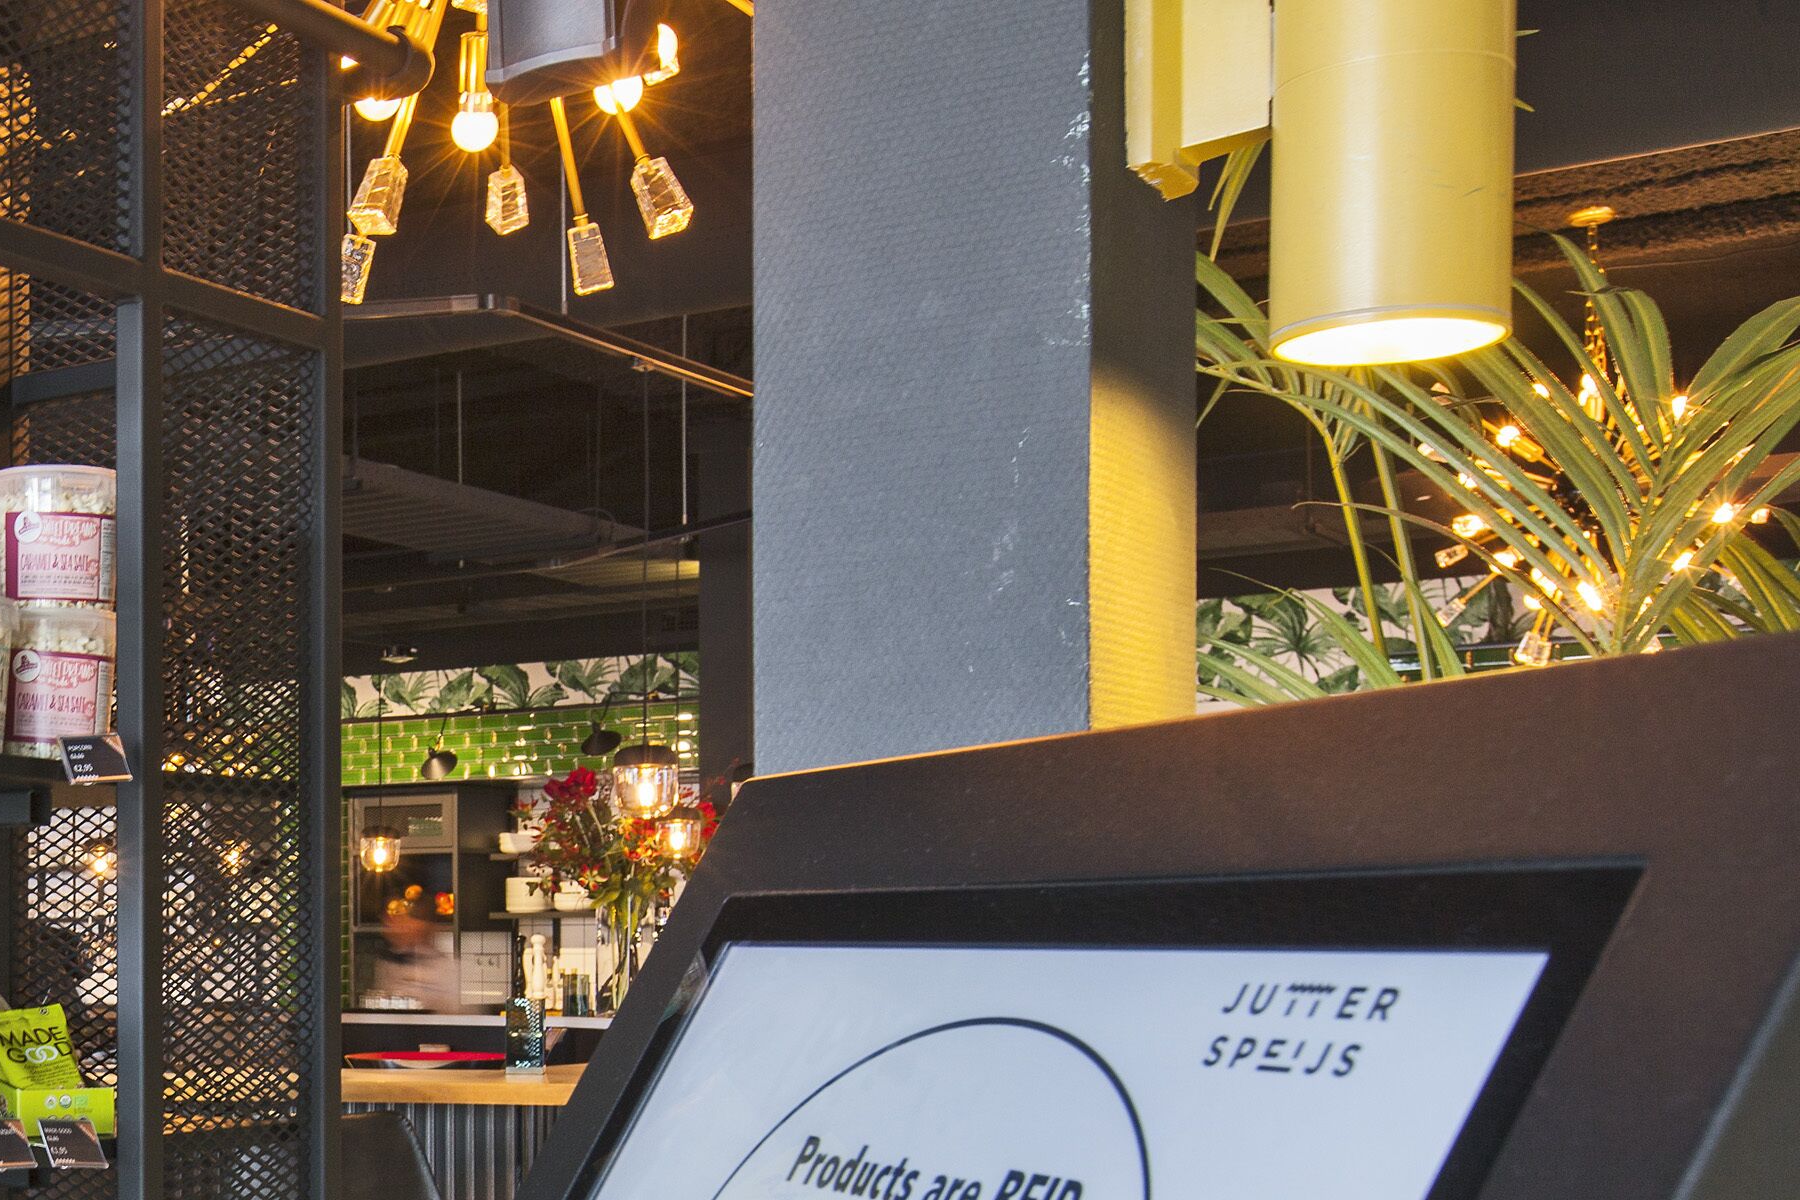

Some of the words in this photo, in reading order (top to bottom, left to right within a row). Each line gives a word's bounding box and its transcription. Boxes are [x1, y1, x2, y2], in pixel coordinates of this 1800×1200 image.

[1222, 982, 1400, 1021] JUTTER
[6, 1041, 73, 1064] GOOD
[1203, 1035, 1361, 1077] SPEIJS
